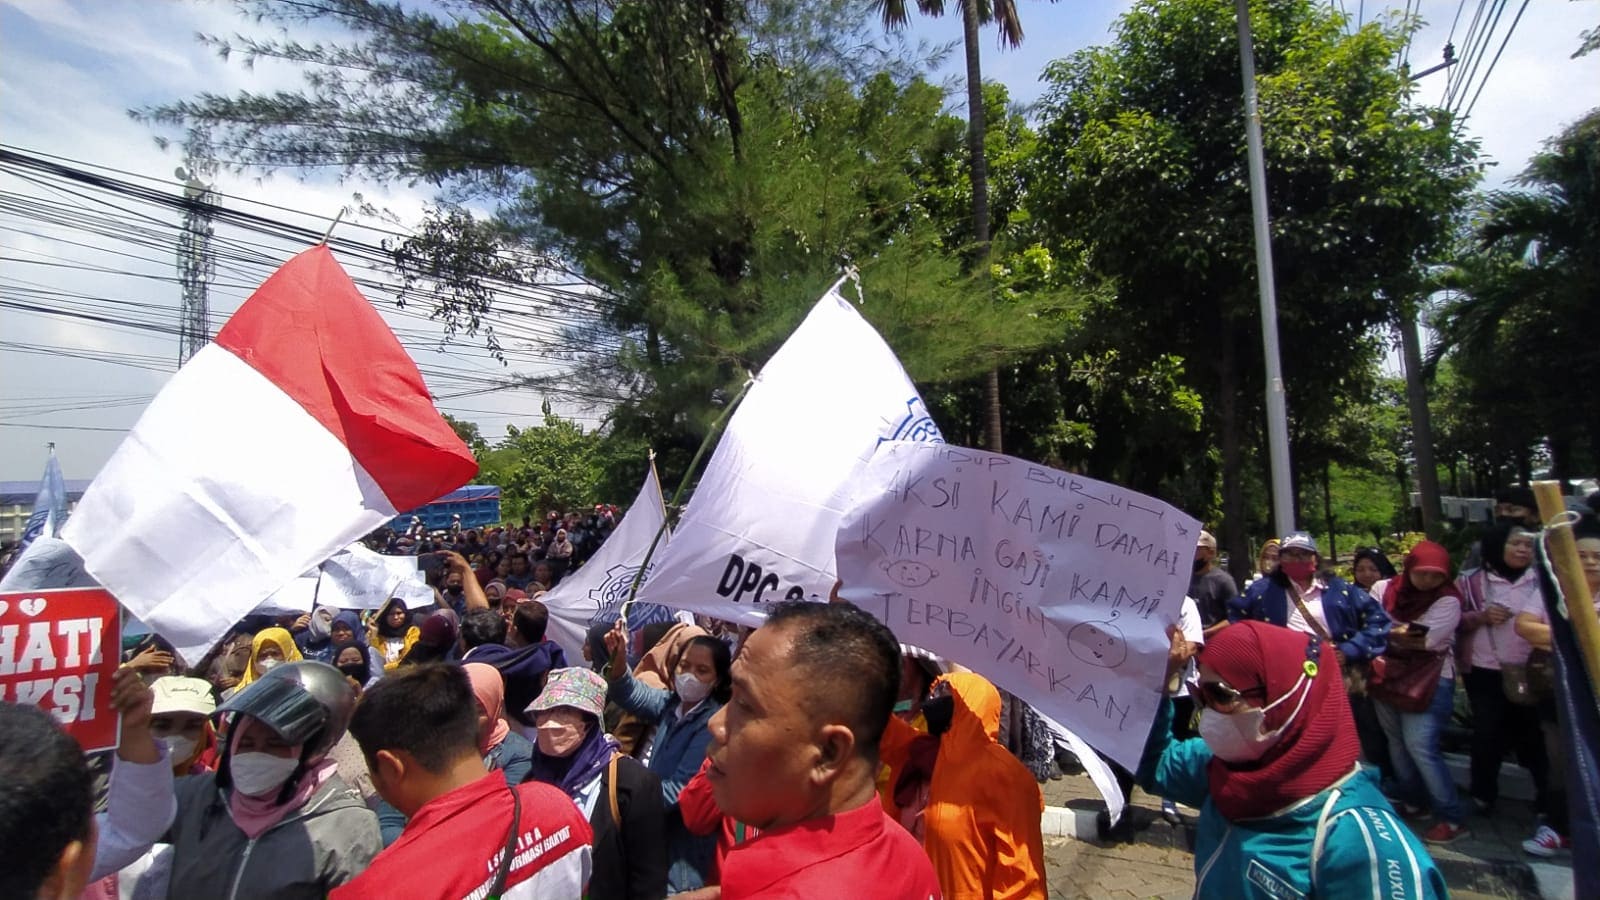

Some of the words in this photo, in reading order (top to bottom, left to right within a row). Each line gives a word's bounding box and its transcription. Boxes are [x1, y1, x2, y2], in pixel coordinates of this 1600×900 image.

[1024, 467, 1164, 520] BURUH
[861, 513, 976, 561] KARNA
[1095, 523, 1180, 576] DAMAI
[873, 592, 1131, 732] TERBAYARKAN
